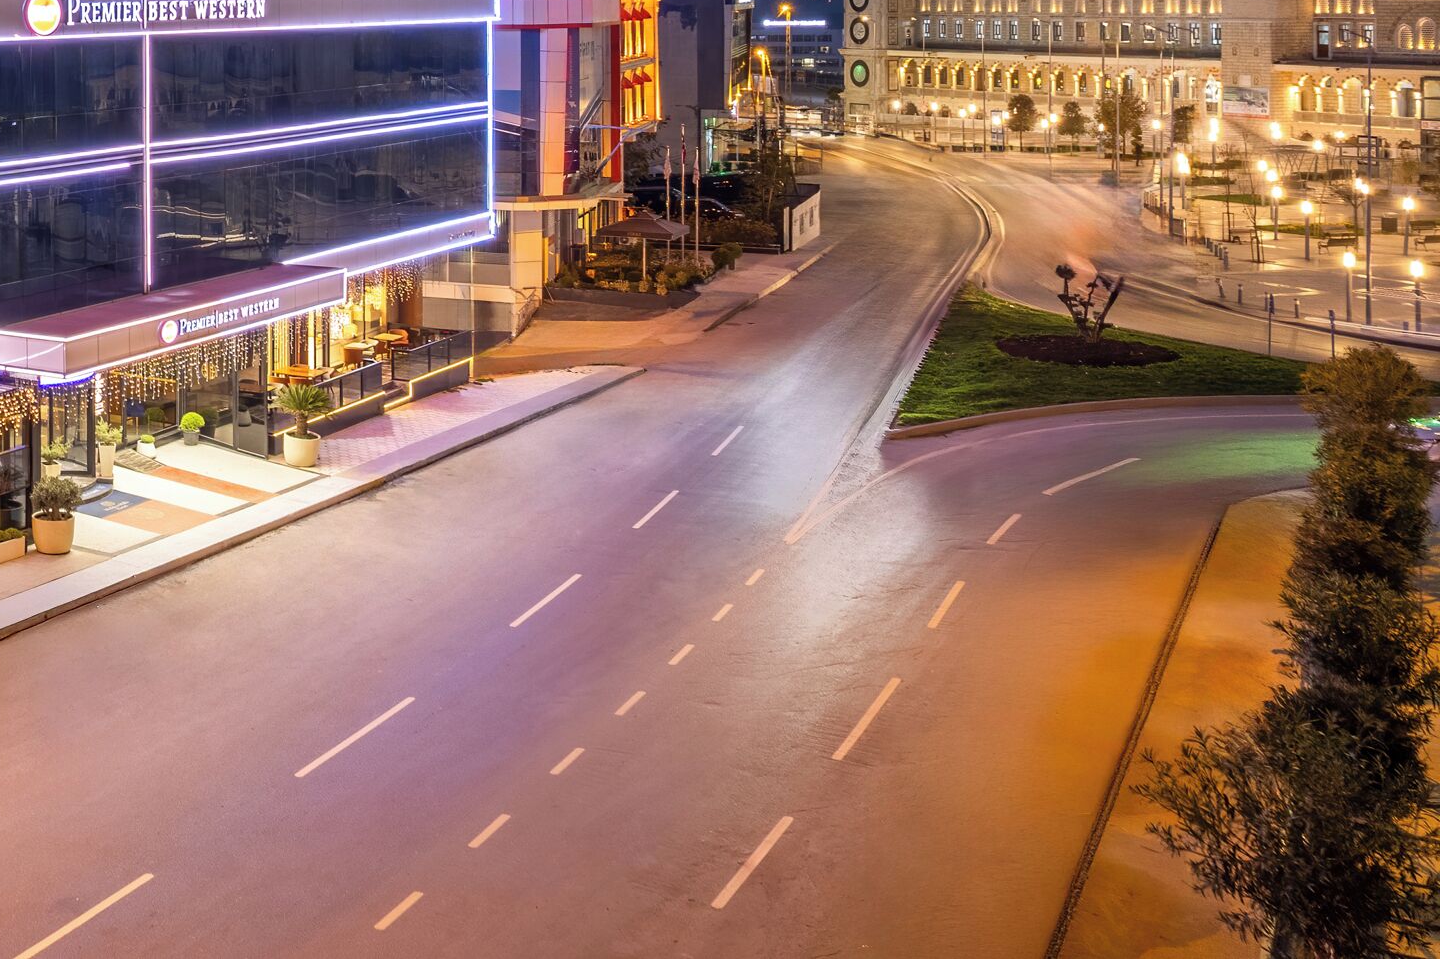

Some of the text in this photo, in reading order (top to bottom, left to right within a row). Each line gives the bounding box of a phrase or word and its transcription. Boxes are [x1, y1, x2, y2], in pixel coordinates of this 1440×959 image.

[148, 0, 189, 22] BEST
[179, 313, 216, 335] PREMIER
[218, 308, 240, 325] BEST
[240, 297, 280, 318] WESTERN
